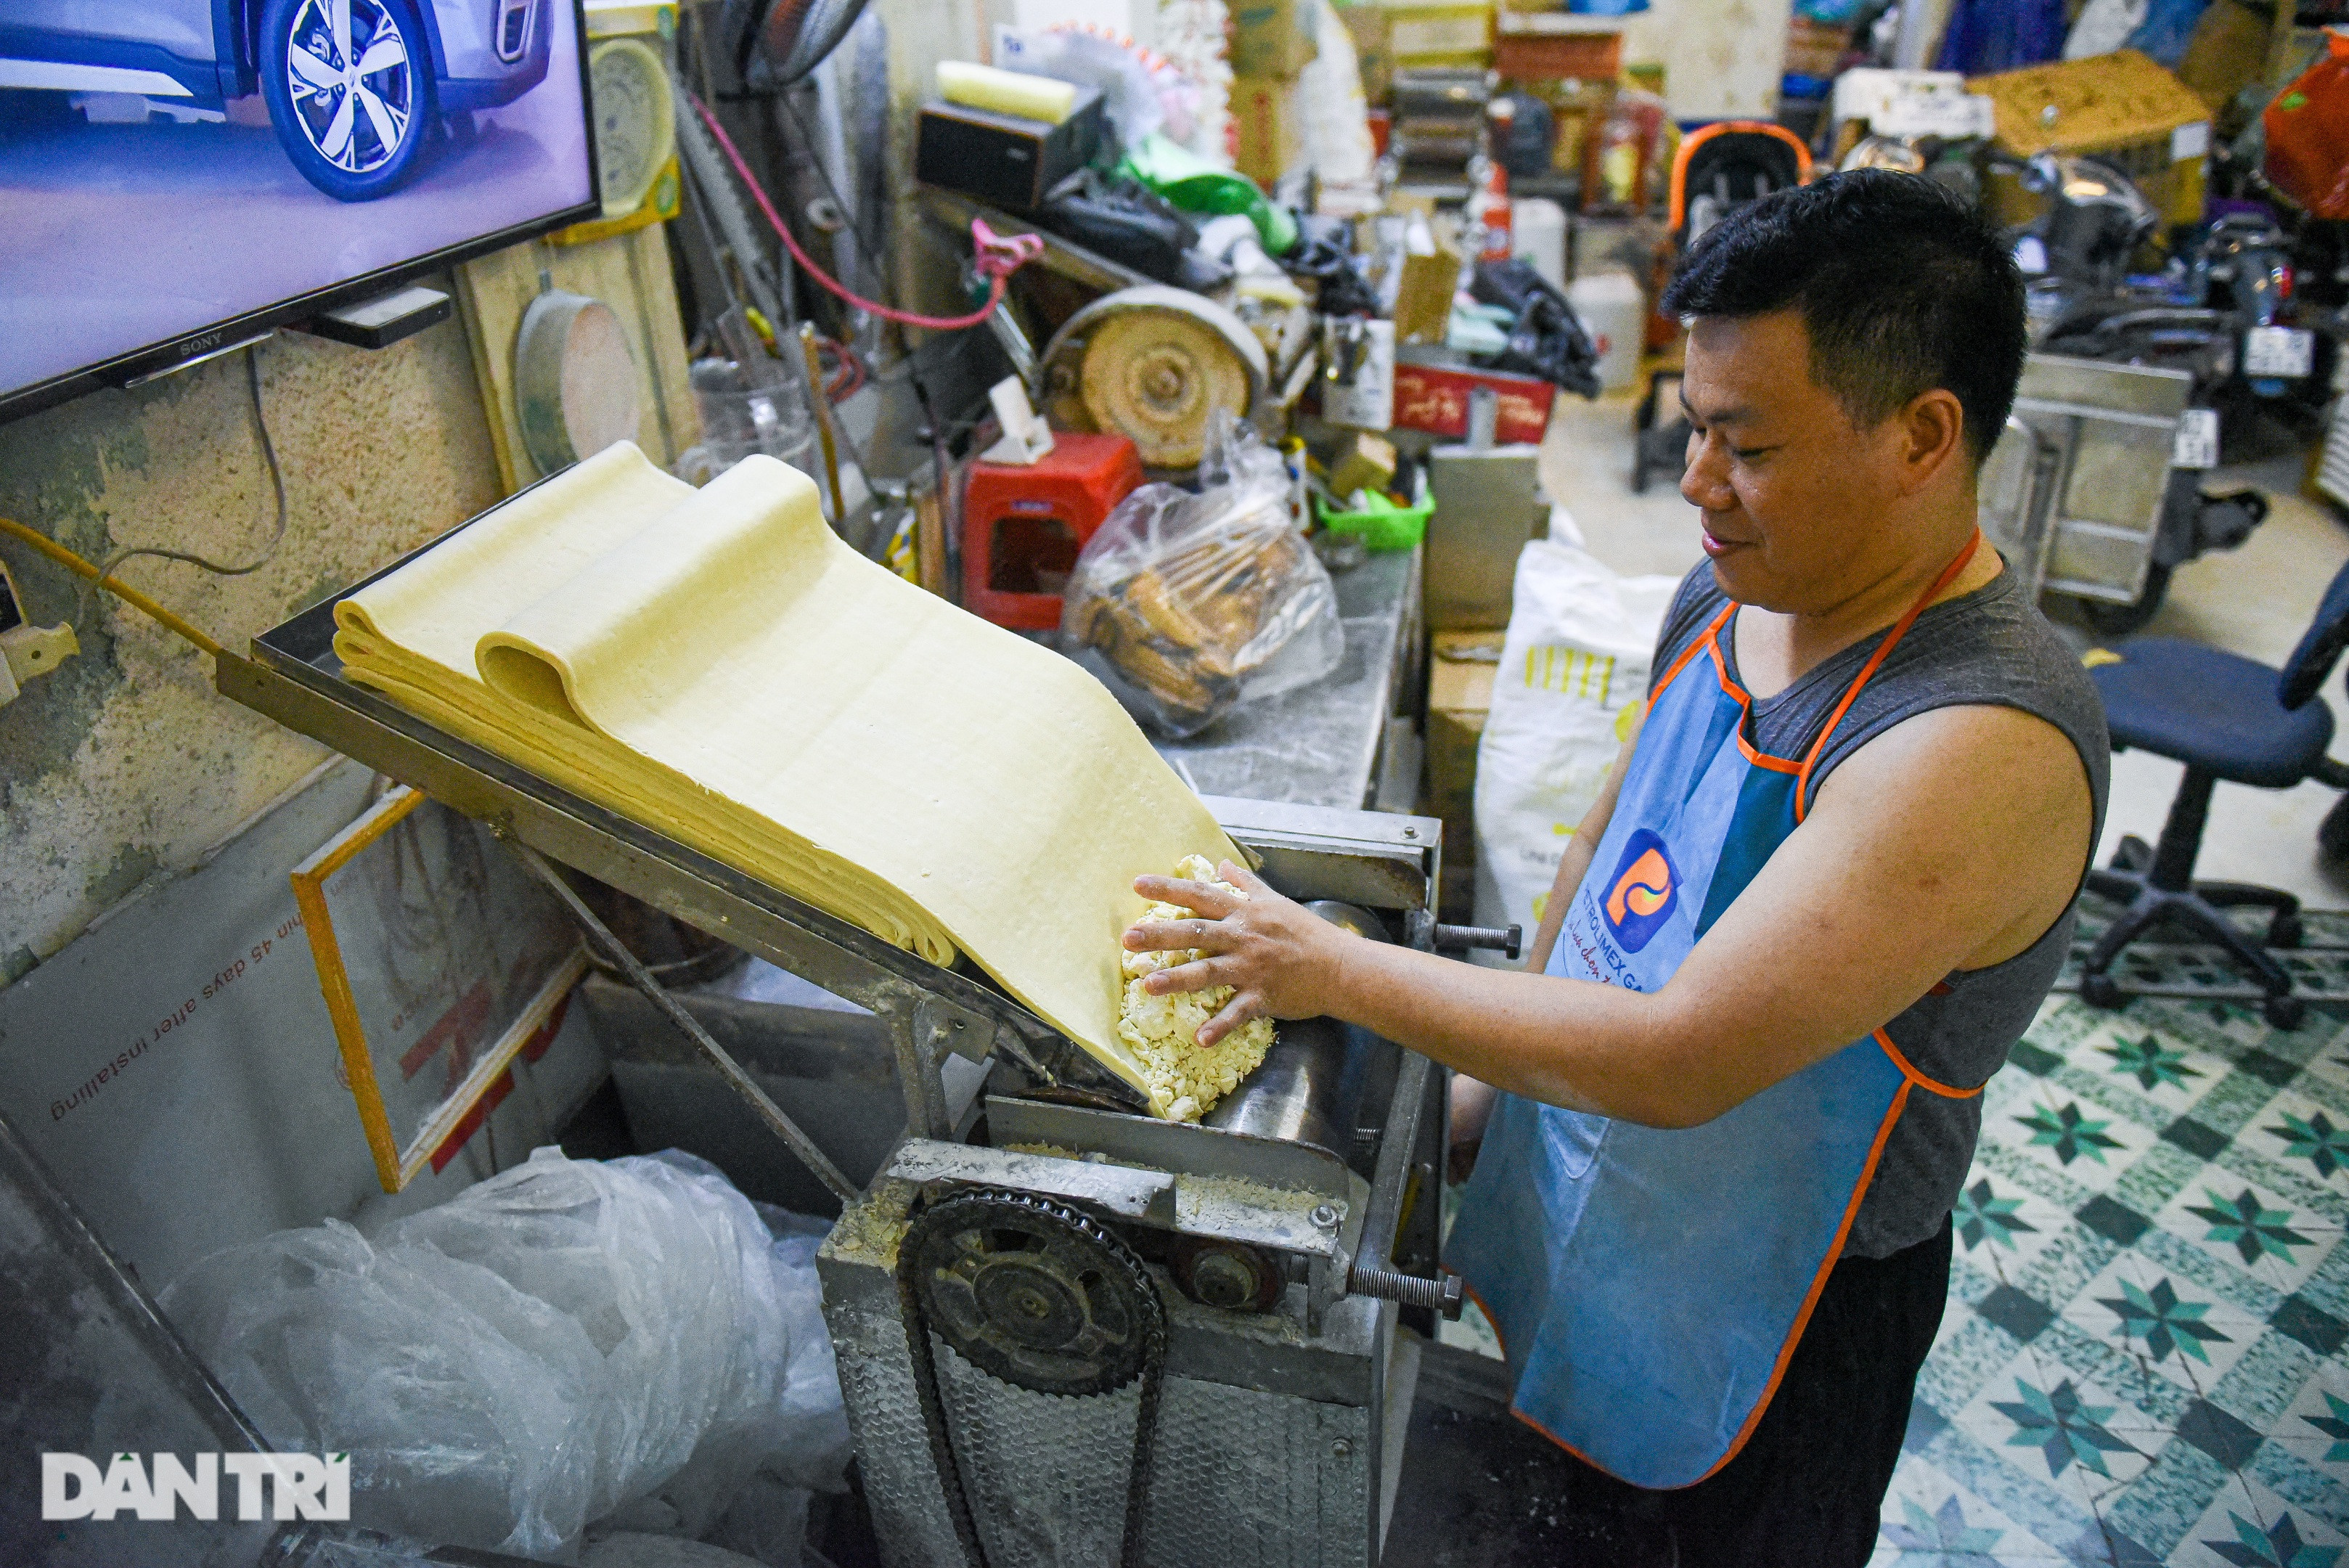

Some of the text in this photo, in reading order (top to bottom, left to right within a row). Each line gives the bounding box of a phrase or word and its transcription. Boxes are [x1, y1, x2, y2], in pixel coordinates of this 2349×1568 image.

[180, 332, 222, 356] SONY
[49, 913, 304, 1122] hin 45 days after installing
